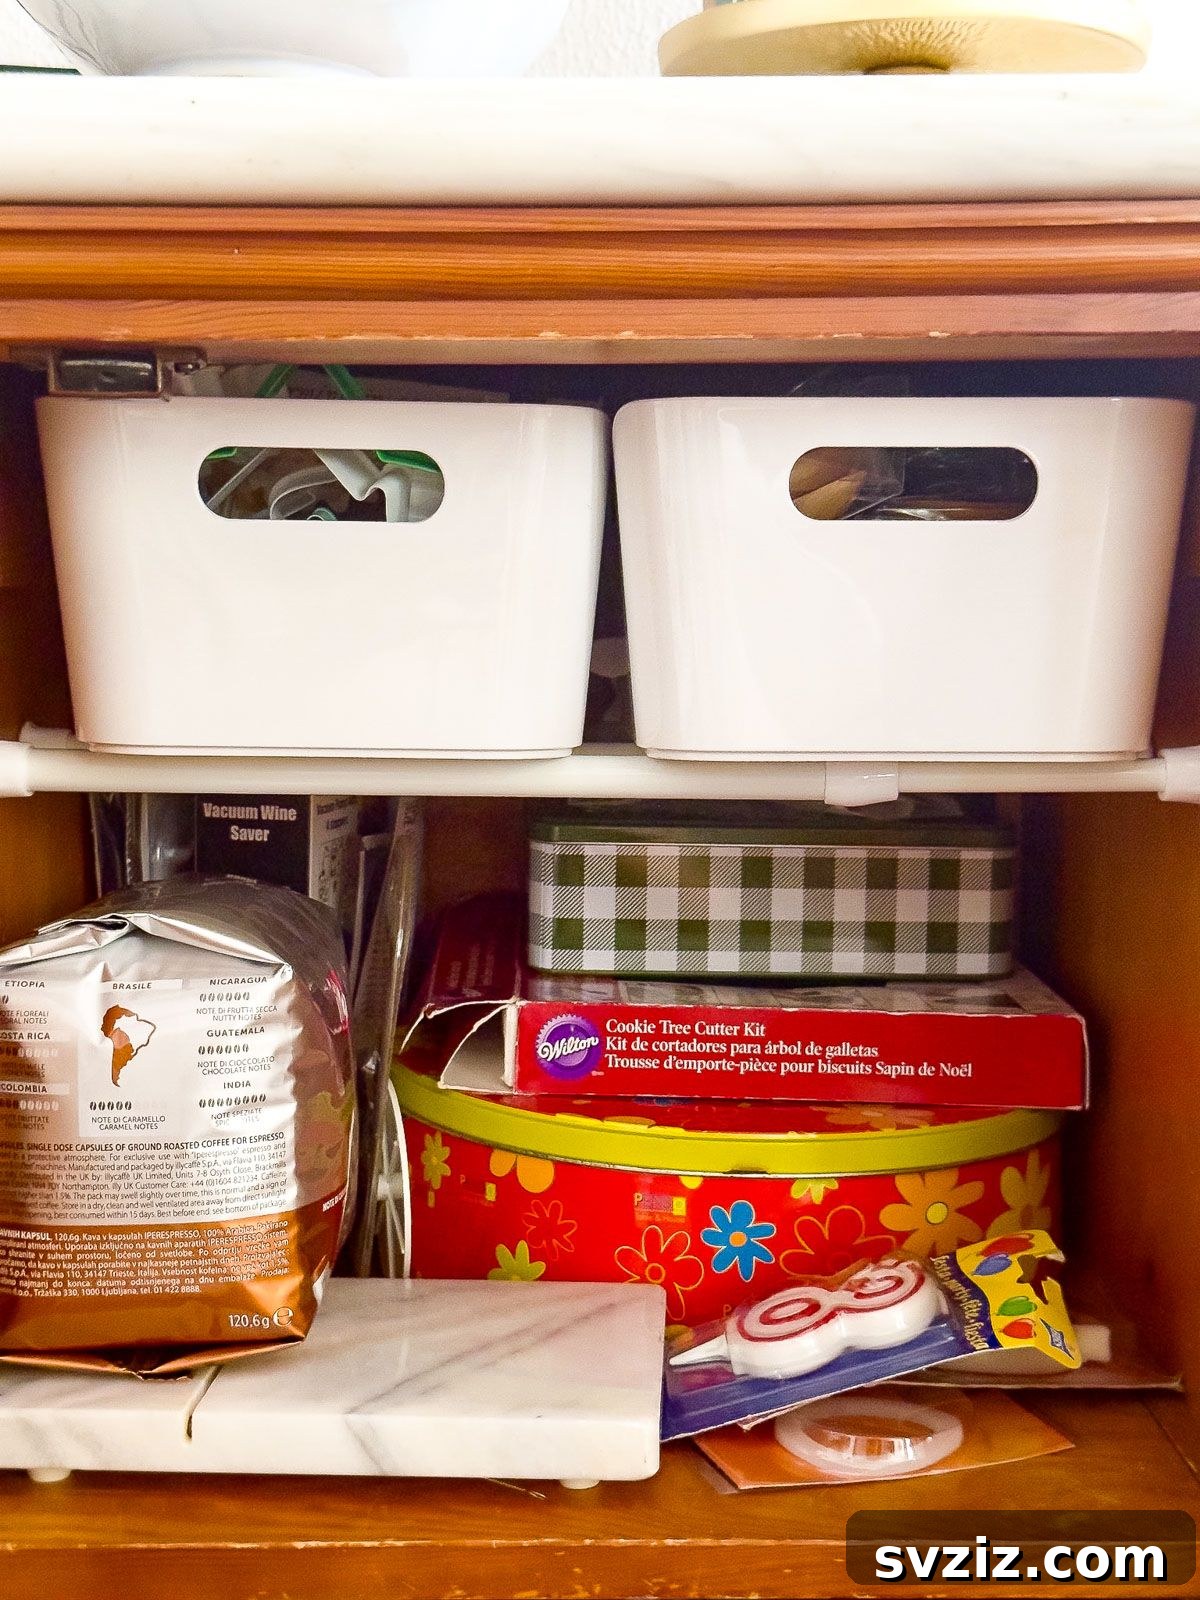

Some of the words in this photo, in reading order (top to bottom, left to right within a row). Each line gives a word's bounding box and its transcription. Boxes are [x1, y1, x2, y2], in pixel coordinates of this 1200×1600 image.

[203, 802, 258, 819] Vacuum
[260, 805, 297, 821] Wine
[230, 825, 270, 842] Saver
[5, 980, 45, 988] ETIOPIA
[209, 976, 267, 985] NICARAGUA
[112, 982, 152, 990] BRASILE
[255, 1005, 278, 1013] SECCA
[23, 1017, 47, 1025] NOTES
[206, 1026, 265, 1037] GUATEMALA
[606, 1018, 656, 1034] Cookie
[659, 1020, 691, 1035] Tree
[694, 1021, 740, 1036] Cutter
[743, 1022, 766, 1037] Kit
[27, 1032, 50, 1040] RICA
[537, 1036, 599, 1061] Wilton
[605, 1037, 627, 1050] Kit
[631, 1037, 649, 1051] de
[651, 1038, 727, 1053] cortadores
[730, 1042, 761, 1057] para
[764, 1040, 802, 1055] árbol
[805, 1041, 822, 1056] de
[825, 1042, 878, 1059] galletas
[228, 1056, 275, 1067] CIOCCOLATO
[604, 1053, 660, 1069] Trousse
[780, 1061, 815, 1076] pour
[817, 1059, 872, 1075] biscuits
[875, 1061, 915, 1078] Sapin
[918, 1062, 936, 1076] de
[939, 1061, 973, 1078] Noël
[202, 1066, 246, 1075] CHOCOLATE
[248, 1064, 271, 1072] NOTES
[0, 1083, 47, 1093] COLOMBIA
[223, 1080, 251, 1089] INDIA
[91, 1116, 112, 1124] NOTE
[122, 1115, 166, 1123] CARAMELLO
[211, 1112, 230, 1120] NOTE
[134, 1122, 159, 1130] NOTES
[27, 1143, 51, 1151] SINGLE
[53, 1143, 74, 1151] DOSE
[75, 1143, 113, 1151] CAPSULES
[115, 1143, 126, 1151] OF
[128, 1142, 162, 1151] GROUND
[164, 1141, 199, 1150] ROASTED
[201, 1138, 229, 1148] COFFEE
[232, 1137, 247, 1145] FOR
[249, 1131, 284, 1143] ESPRESSO
